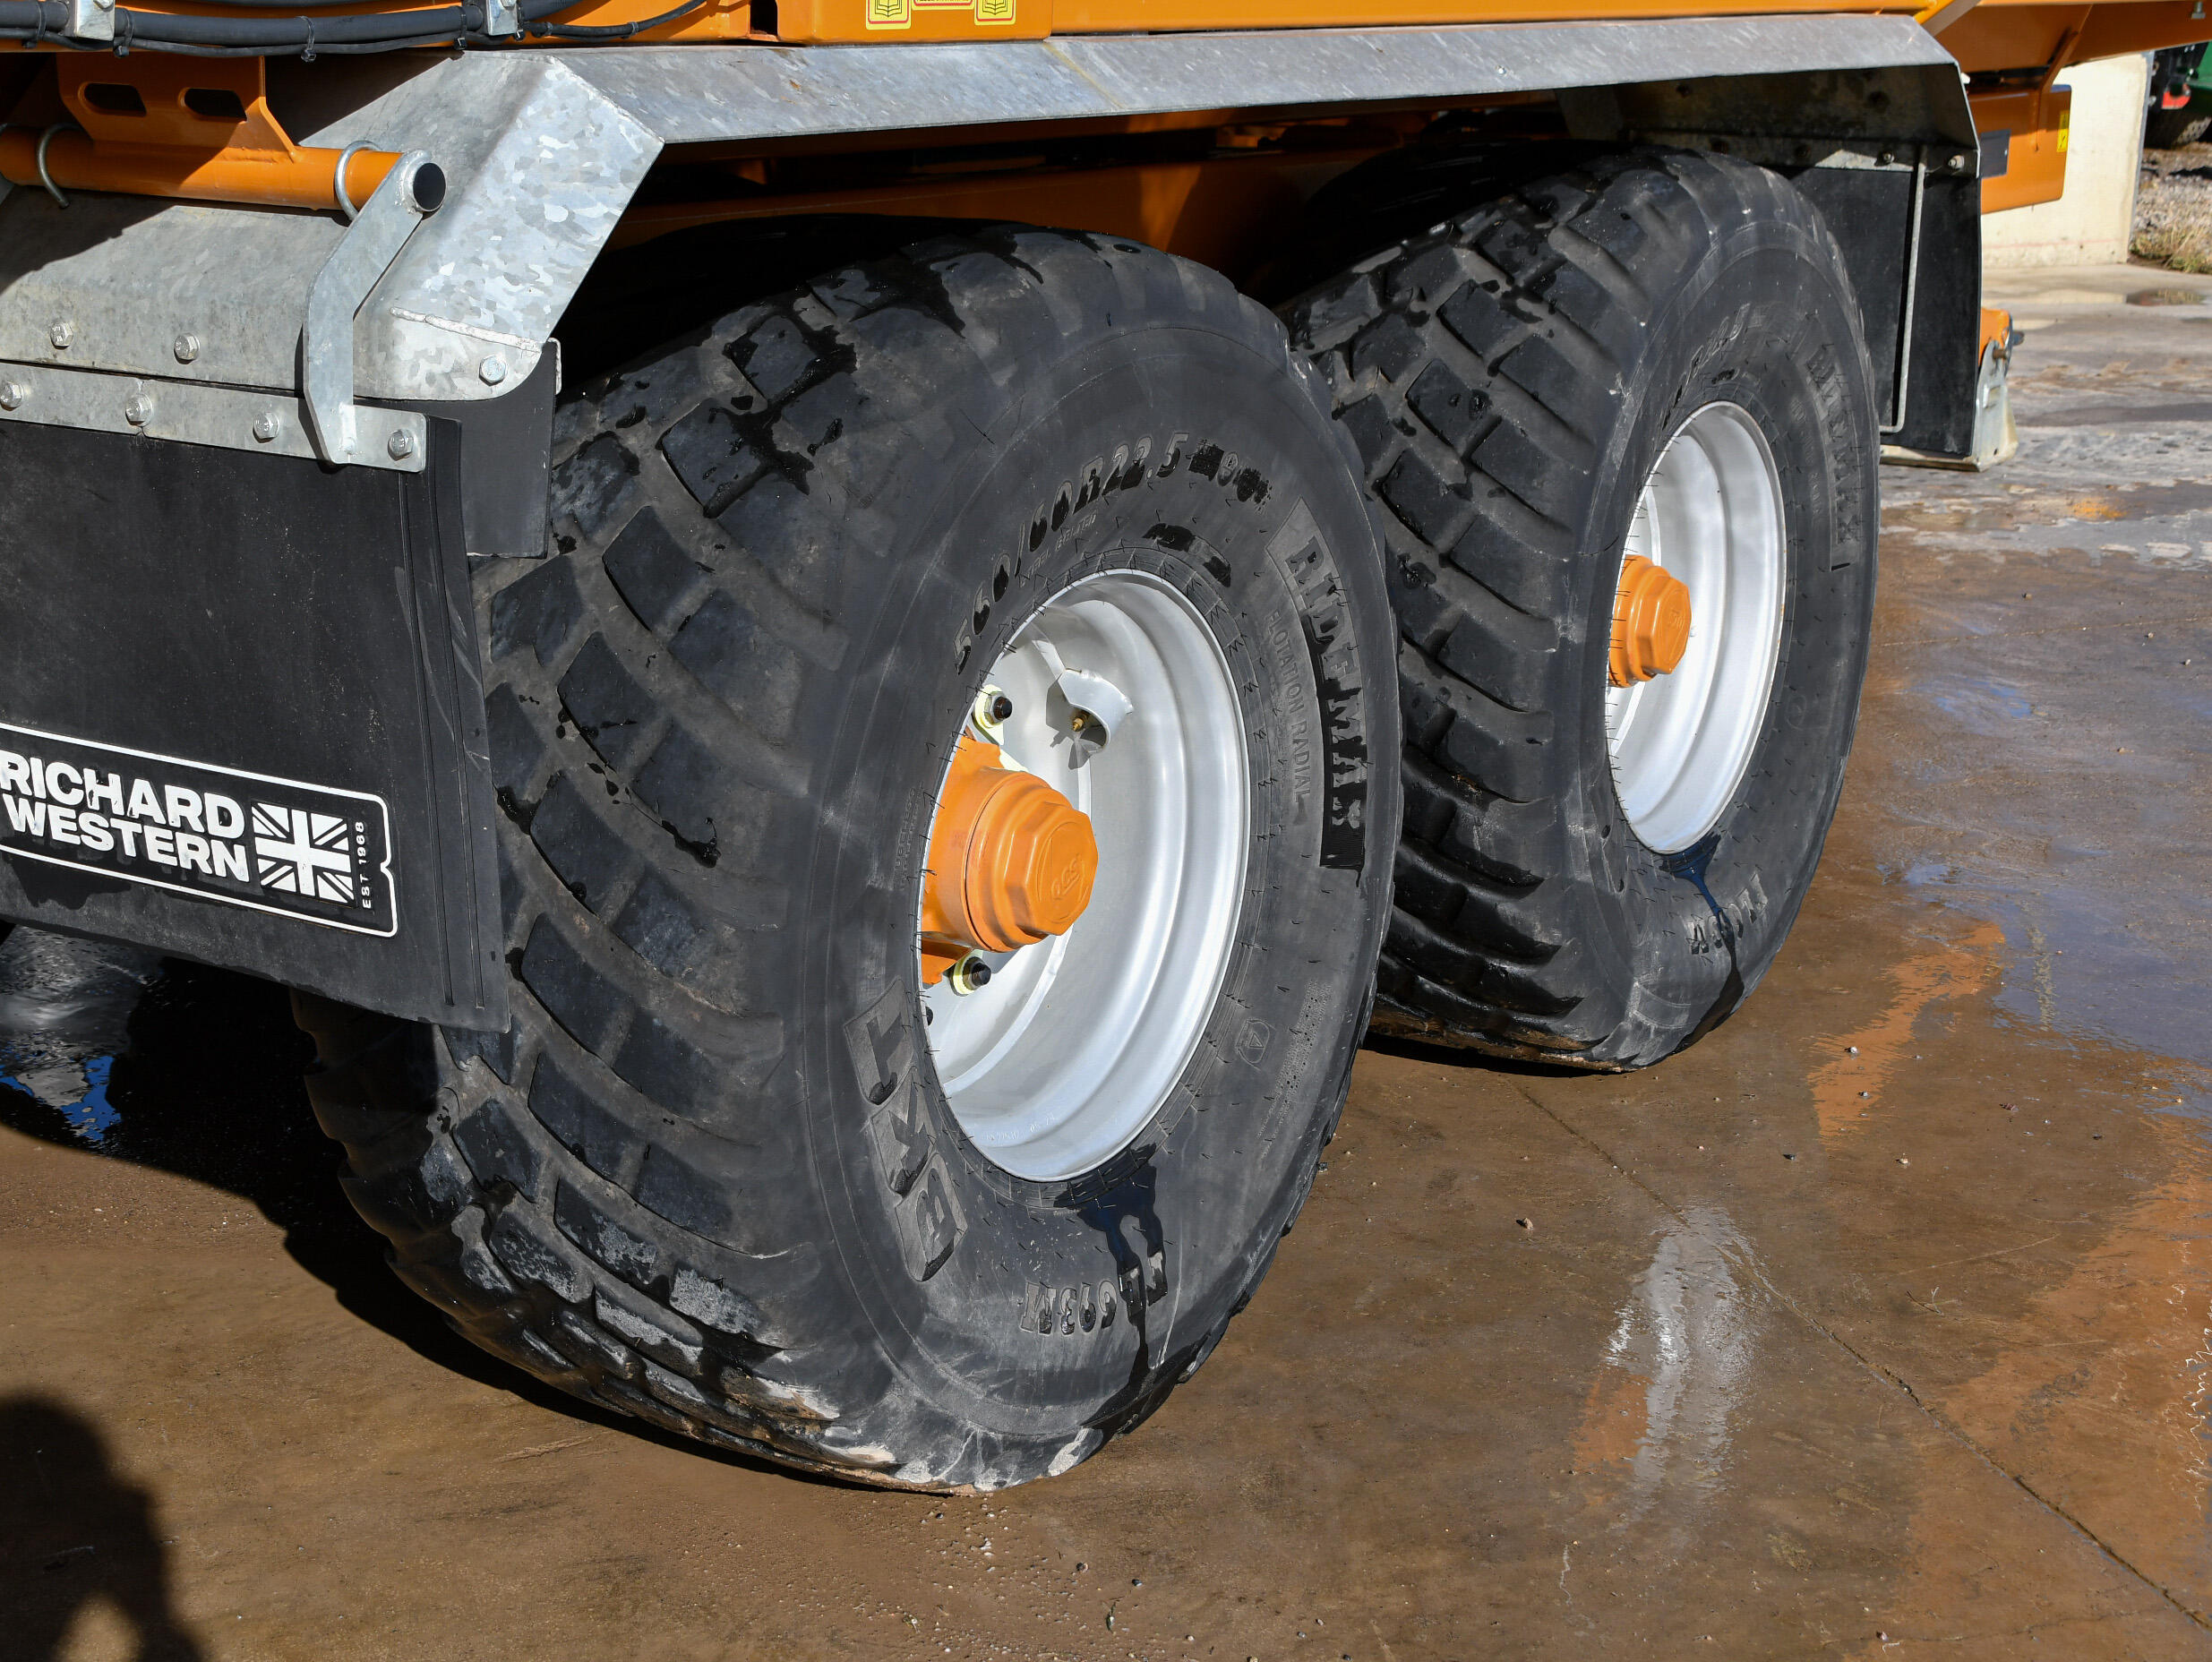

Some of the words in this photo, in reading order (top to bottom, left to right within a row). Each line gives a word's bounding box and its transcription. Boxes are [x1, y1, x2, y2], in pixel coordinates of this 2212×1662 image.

[1264, 608, 1306, 715] FLOTATION
[1290, 718, 1312, 804] RADIAL
[1283, 535, 1367, 830] RIDEMAX
[0, 750, 245, 840] RICHARD
[3, 793, 251, 883] WESTERN
[360, 873, 372, 910] EST
[855, 992, 964, 1281] BKT
[1019, 1279, 1119, 1337] 693M
